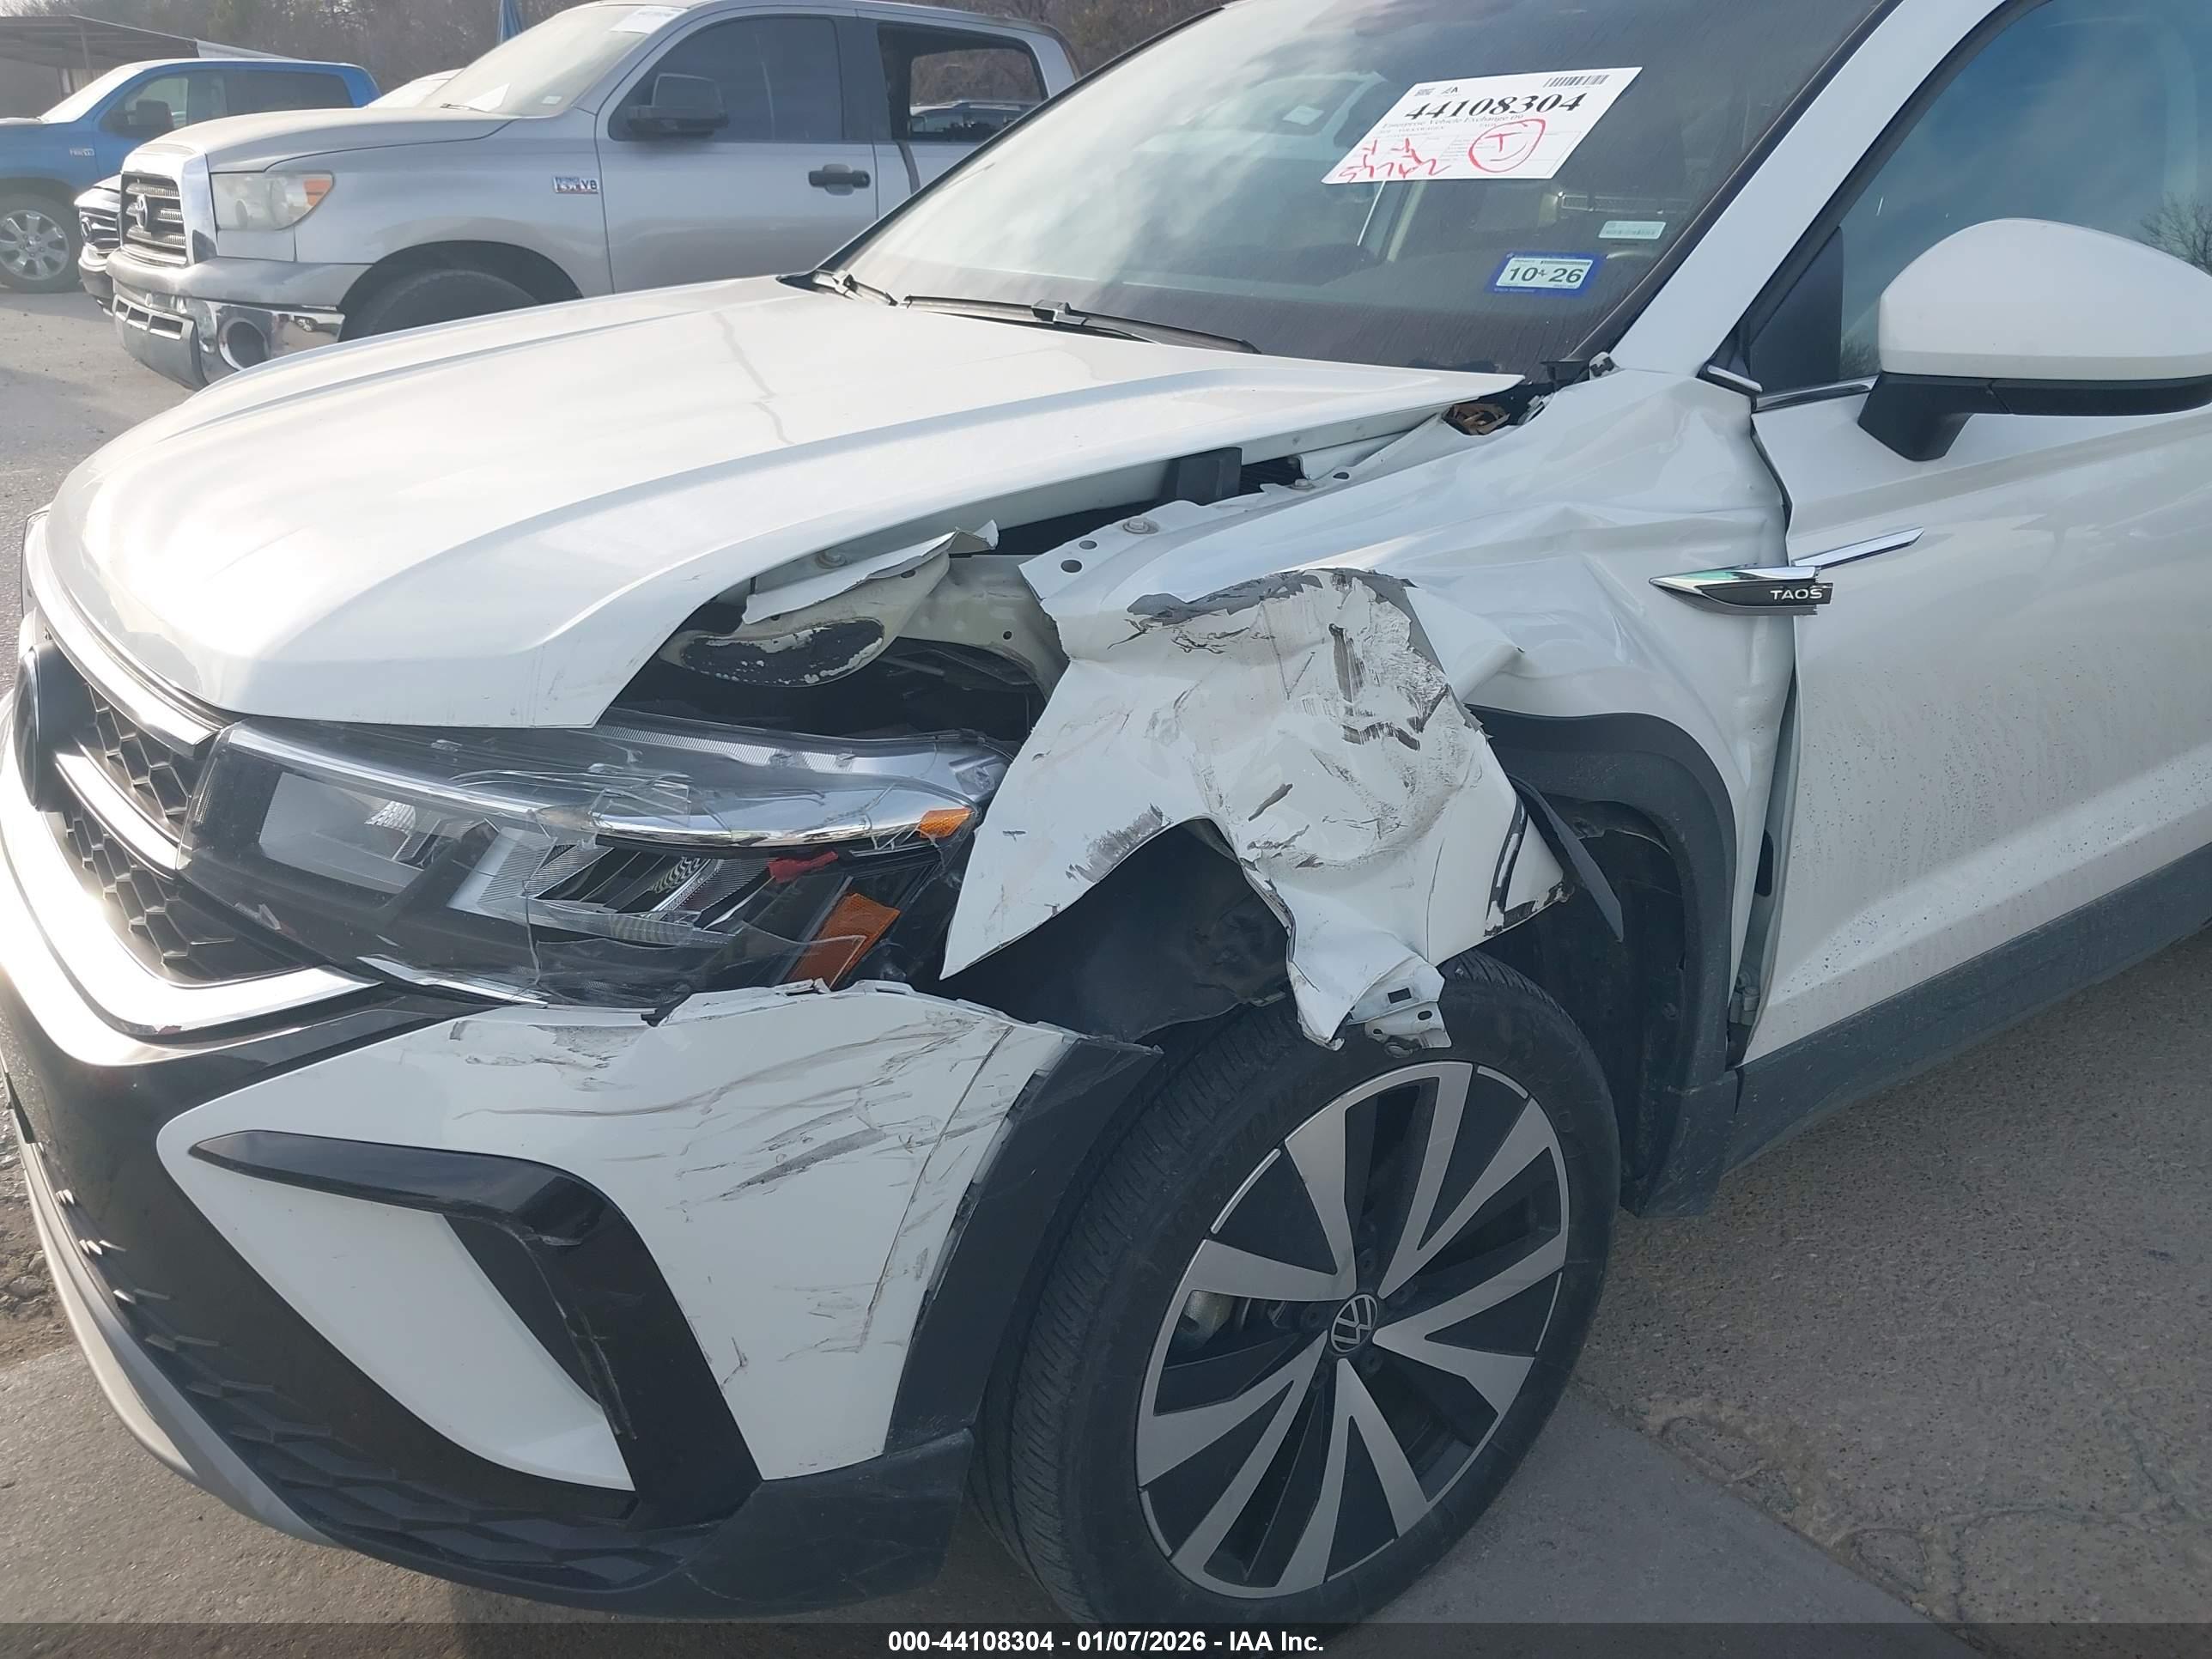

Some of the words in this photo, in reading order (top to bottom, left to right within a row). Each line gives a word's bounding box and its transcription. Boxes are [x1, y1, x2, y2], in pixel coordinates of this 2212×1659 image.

[1405, 93, 1588, 121] 44108304
[1510, 267, 1539, 282] 10
[1548, 268, 1584, 283] 26
[1770, 588, 1823, 600] TAOS
